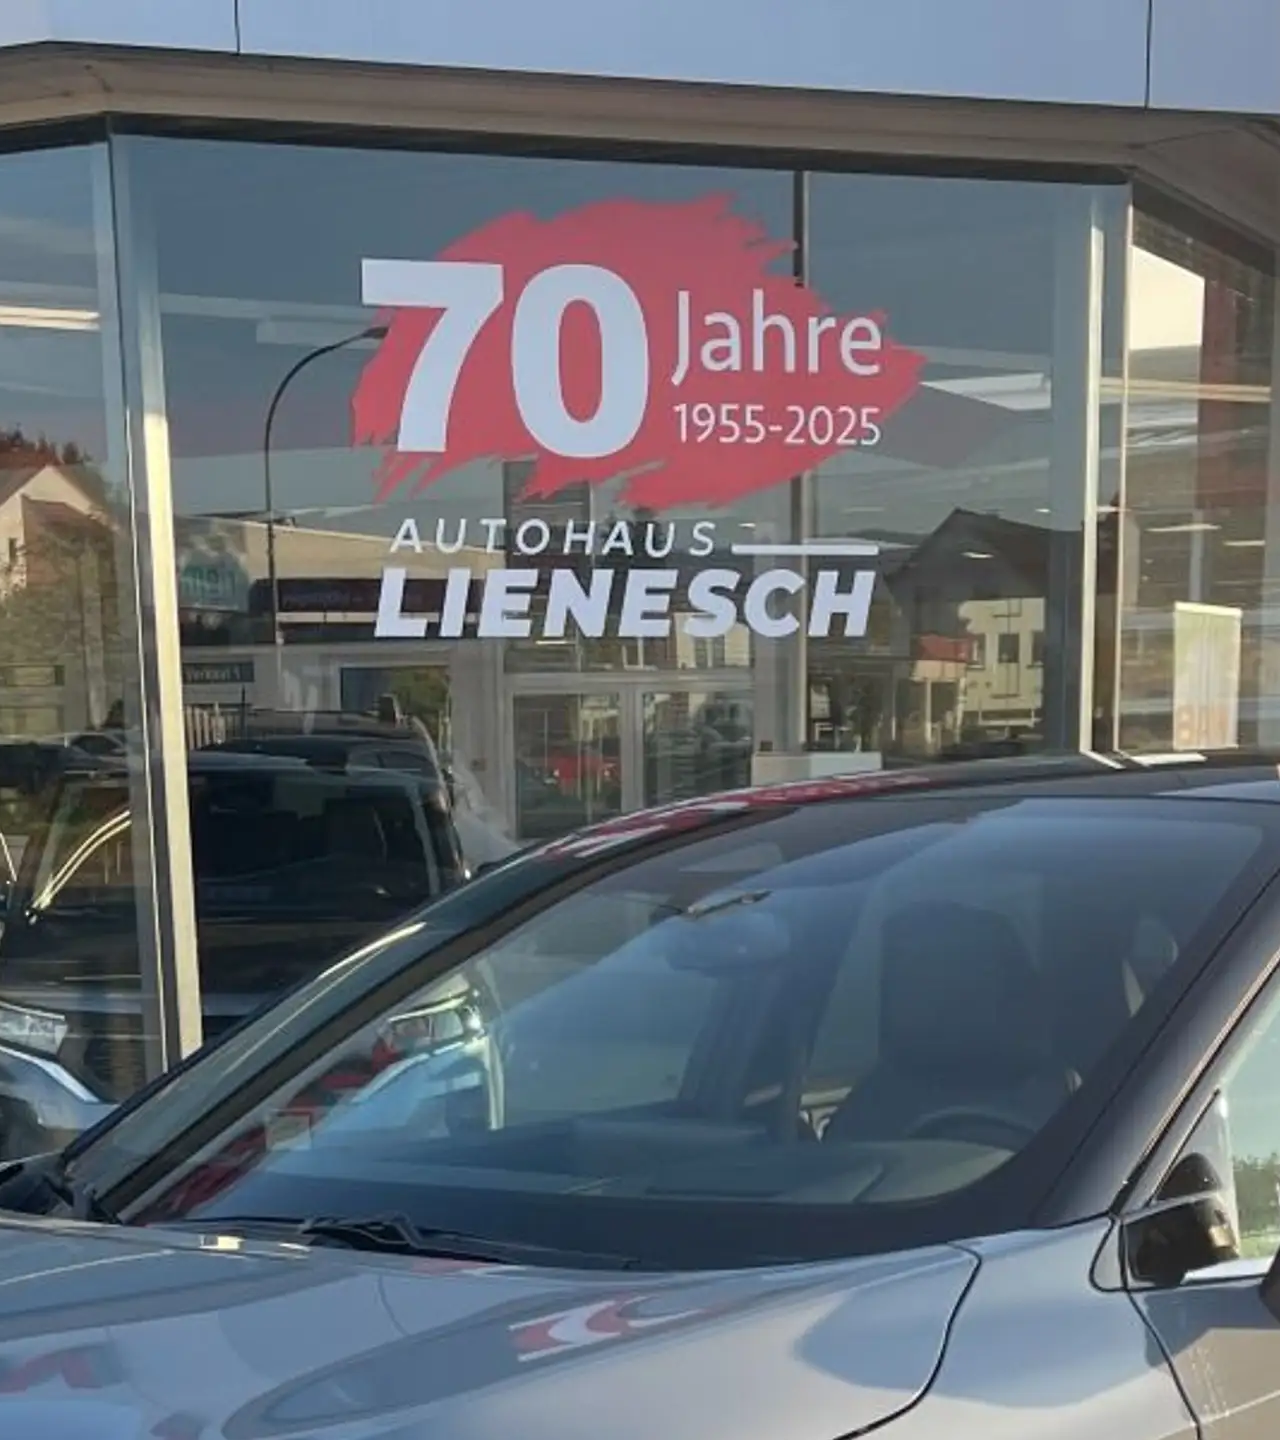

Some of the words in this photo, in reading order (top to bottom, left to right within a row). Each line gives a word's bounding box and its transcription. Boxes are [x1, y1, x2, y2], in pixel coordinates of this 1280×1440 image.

[361, 258, 649, 458] 70
[671, 289, 882, 387] Jahre
[673, 404, 881, 446] 1955-2025
[390, 518, 717, 558] AUTOHAUS
[374, 567, 876, 638] LIENESCH
